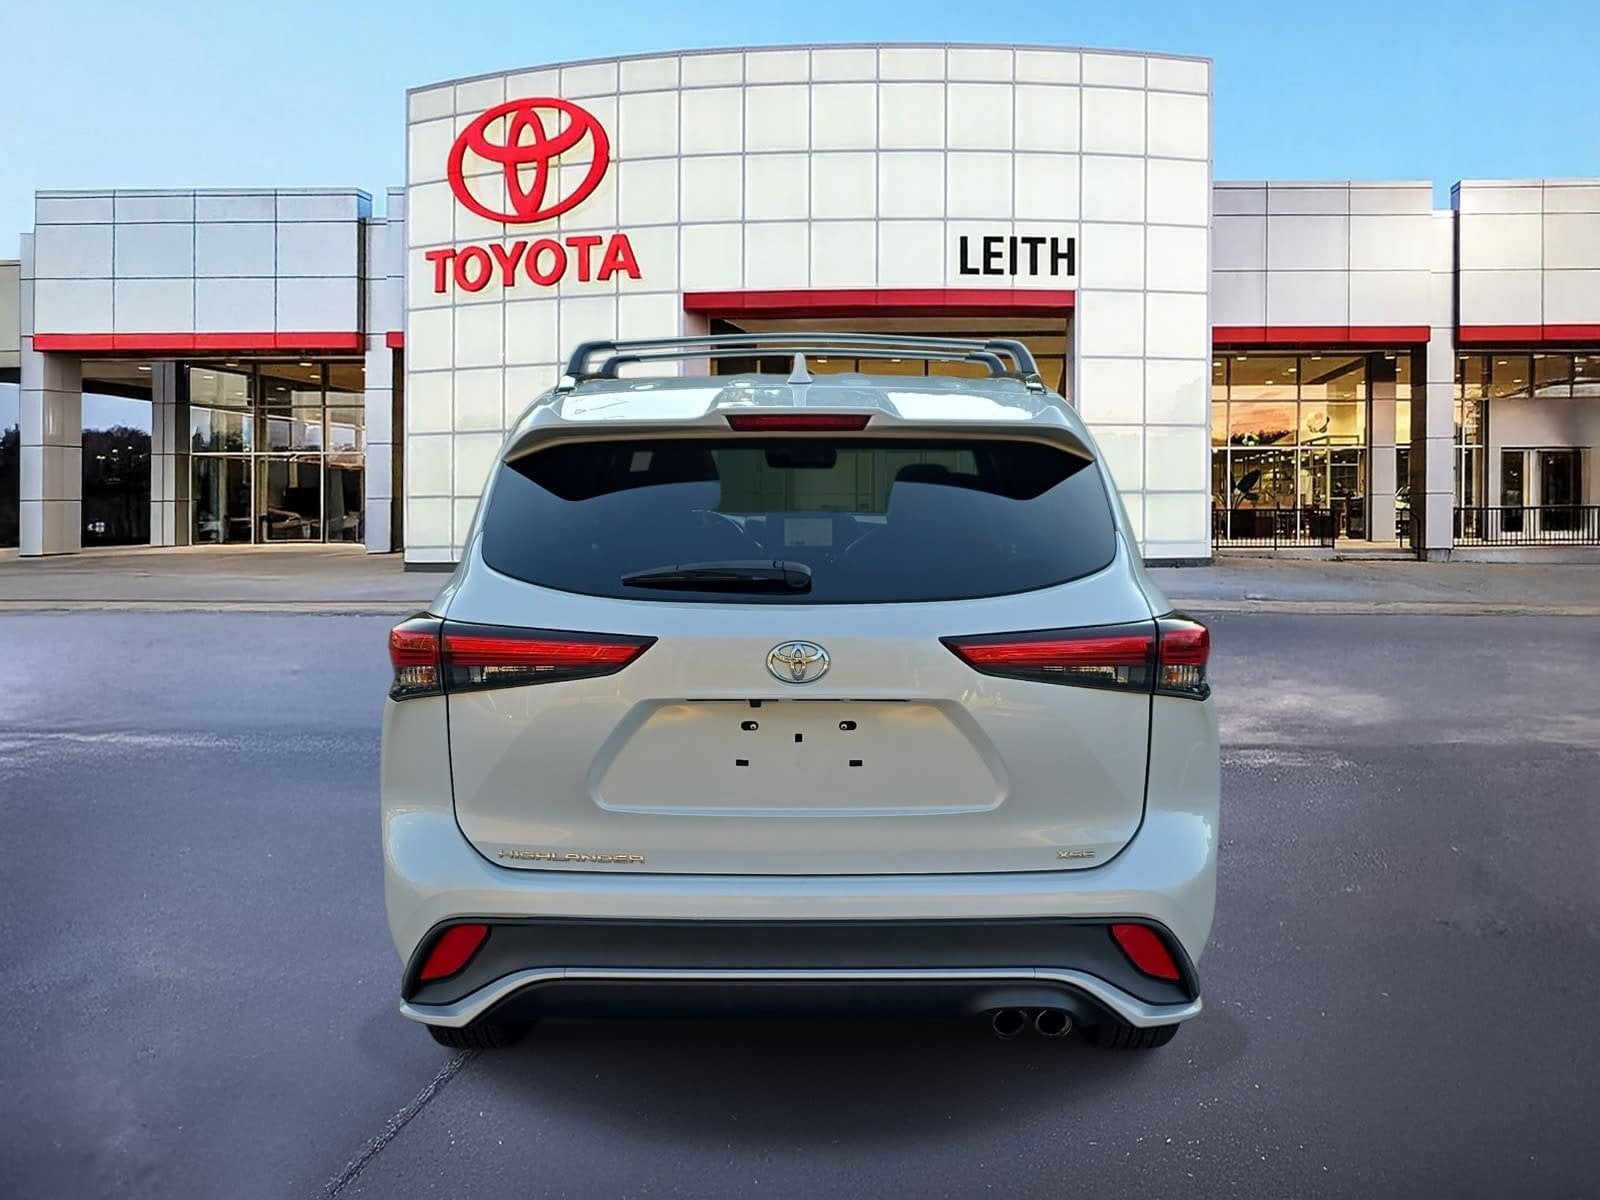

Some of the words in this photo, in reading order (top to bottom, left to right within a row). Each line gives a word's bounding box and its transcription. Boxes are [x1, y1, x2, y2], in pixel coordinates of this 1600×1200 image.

[426, 232, 641, 293] TOYOTA
[959, 236, 1076, 276] LEITH
[498, 848, 646, 864] HIGHLANDER
